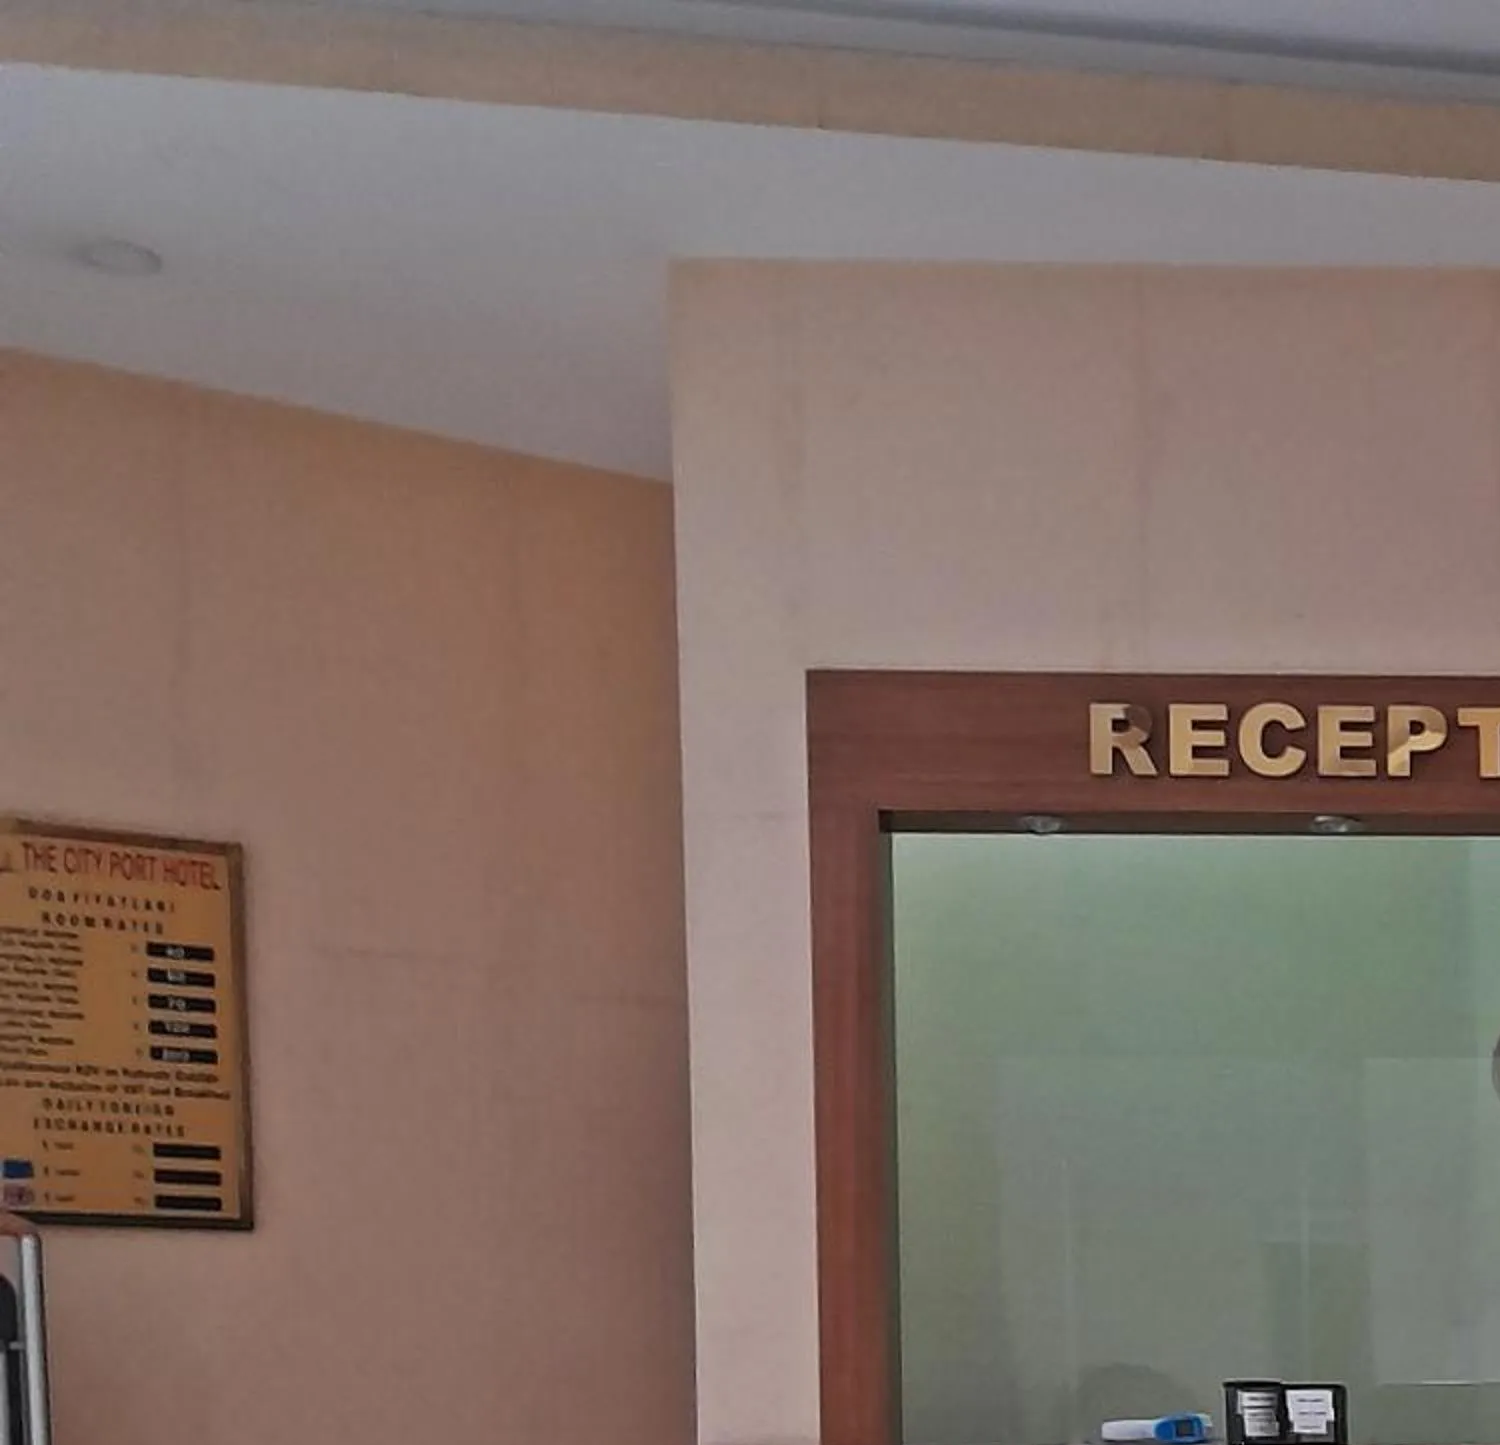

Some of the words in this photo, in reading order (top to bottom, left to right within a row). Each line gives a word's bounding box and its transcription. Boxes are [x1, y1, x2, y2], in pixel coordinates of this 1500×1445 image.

[22, 841, 57, 873] THE
[64, 847, 103, 874] CITY
[109, 850, 158, 881] PORT
[163, 859, 221, 891] HOTEL
